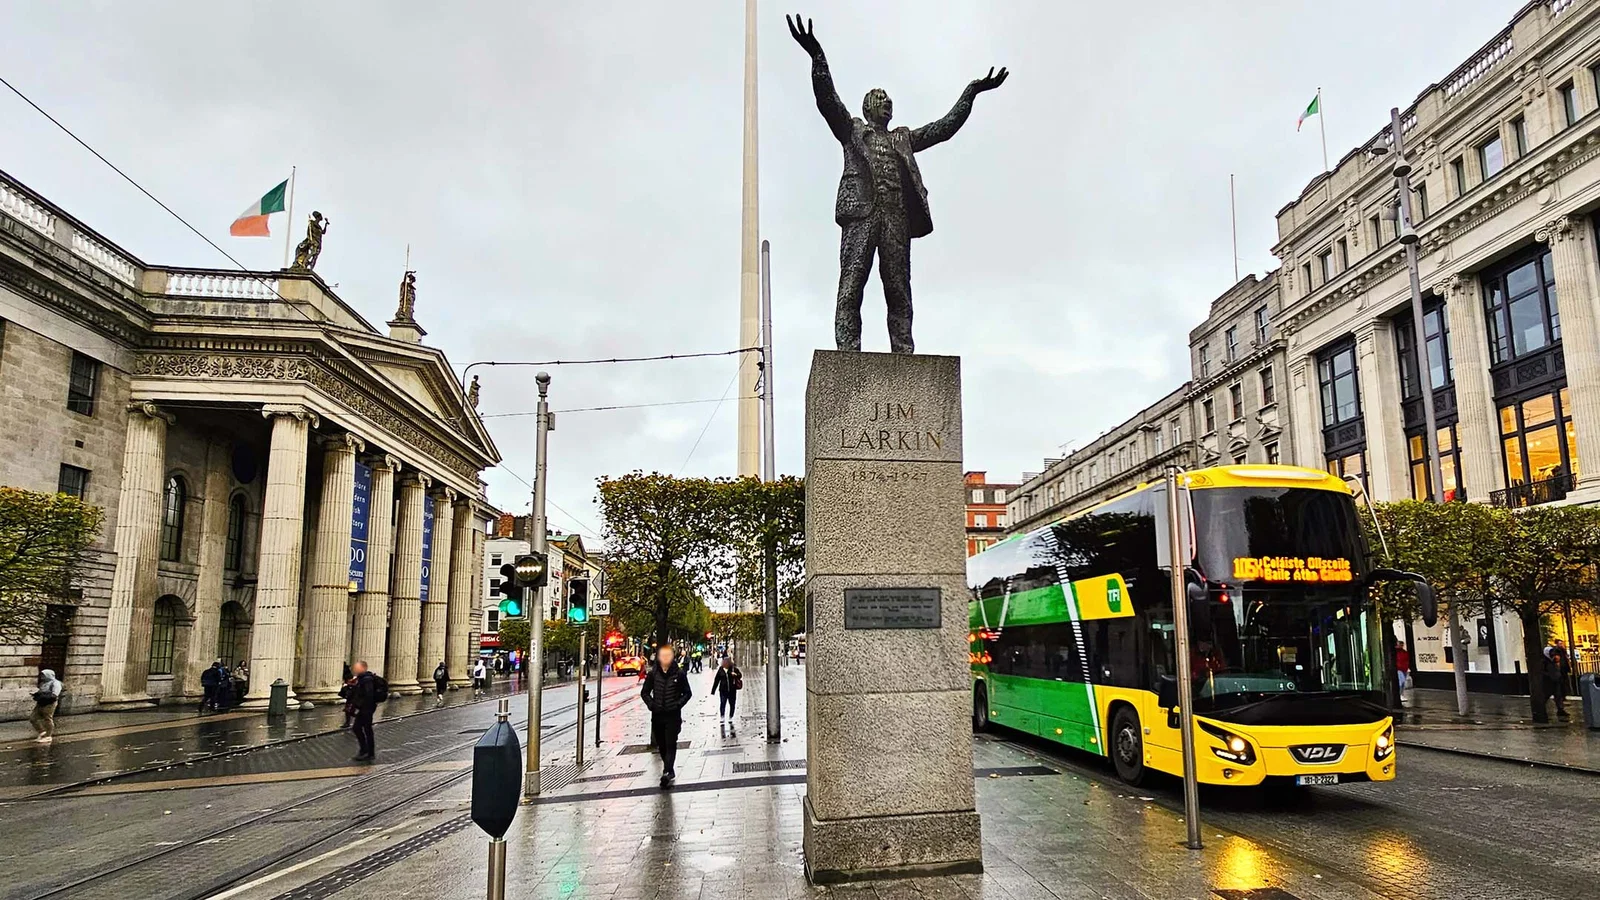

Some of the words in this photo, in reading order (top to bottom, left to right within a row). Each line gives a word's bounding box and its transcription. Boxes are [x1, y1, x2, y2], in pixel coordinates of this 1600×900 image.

[869, 402, 914, 421] JIM
[841, 429, 942, 450] LARKIN
[1264, 569, 1291, 581] Baile
[595, 603, 607, 611] 30
[1297, 747, 1337, 759] VDL
